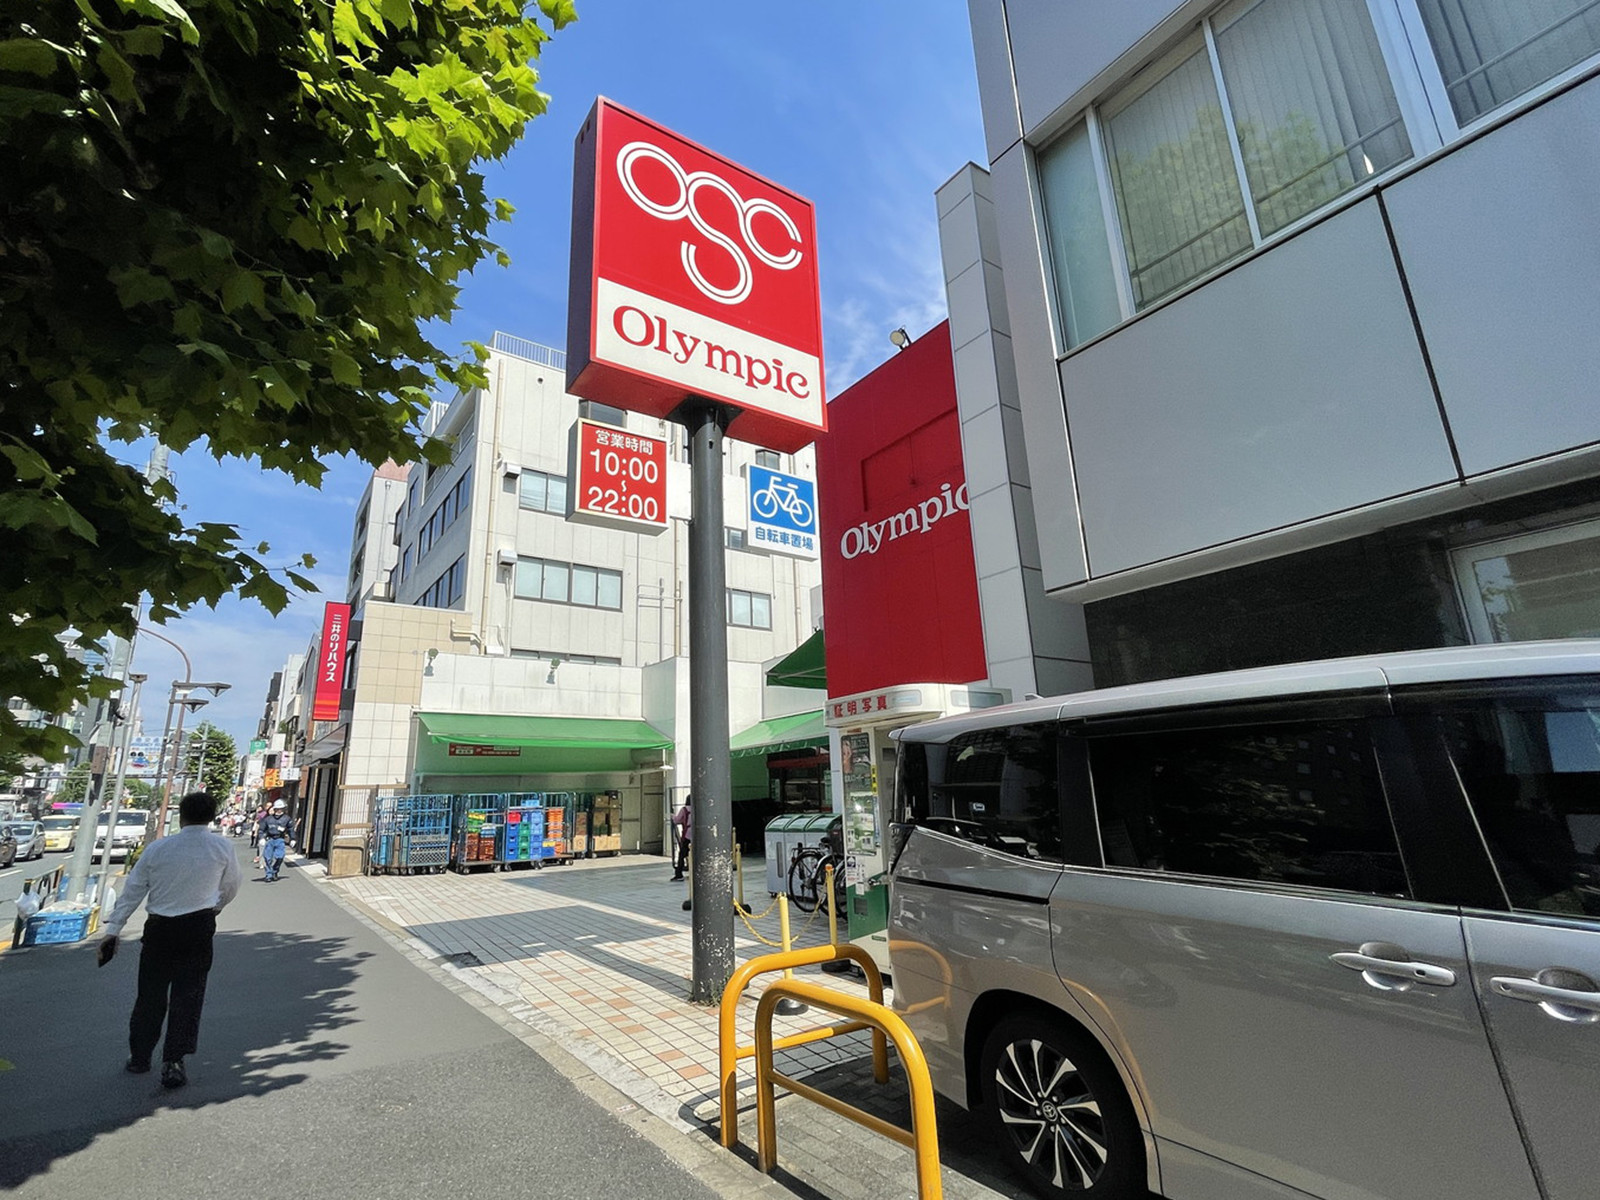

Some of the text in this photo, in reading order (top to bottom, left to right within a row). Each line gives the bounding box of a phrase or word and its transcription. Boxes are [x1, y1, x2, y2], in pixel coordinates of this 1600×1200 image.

[613, 305, 810, 399] Olympic
[595, 430, 653, 455] 営業時間
[590, 449, 658, 483] 10:00
[588, 486, 658, 521] 22:00
[755, 526, 813, 551] 自転車置場
[325, 614, 342, 682] 三井のリハウス
